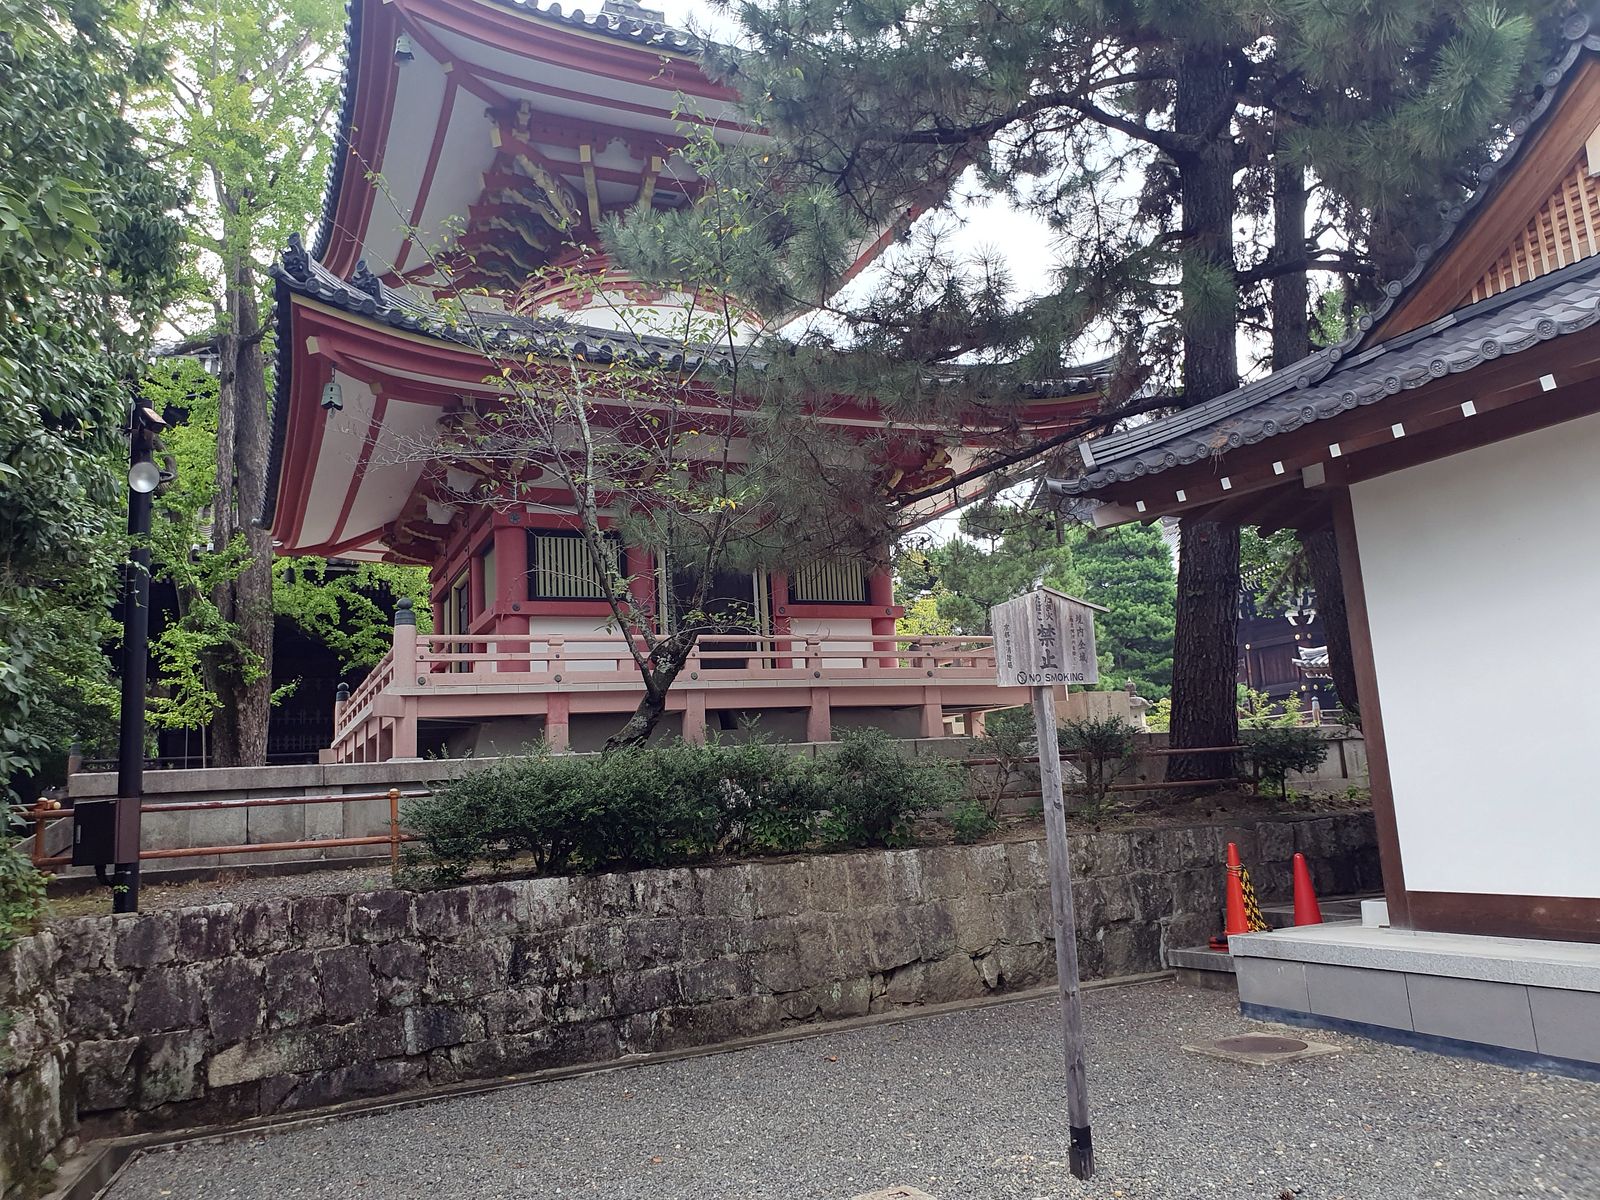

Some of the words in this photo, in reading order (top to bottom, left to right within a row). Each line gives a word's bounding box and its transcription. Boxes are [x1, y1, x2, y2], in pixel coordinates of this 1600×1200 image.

[1037, 623, 1058, 669] 禁止
[1028, 674, 1041, 682] NO
[1045, 672, 1084, 682] SMOKING
